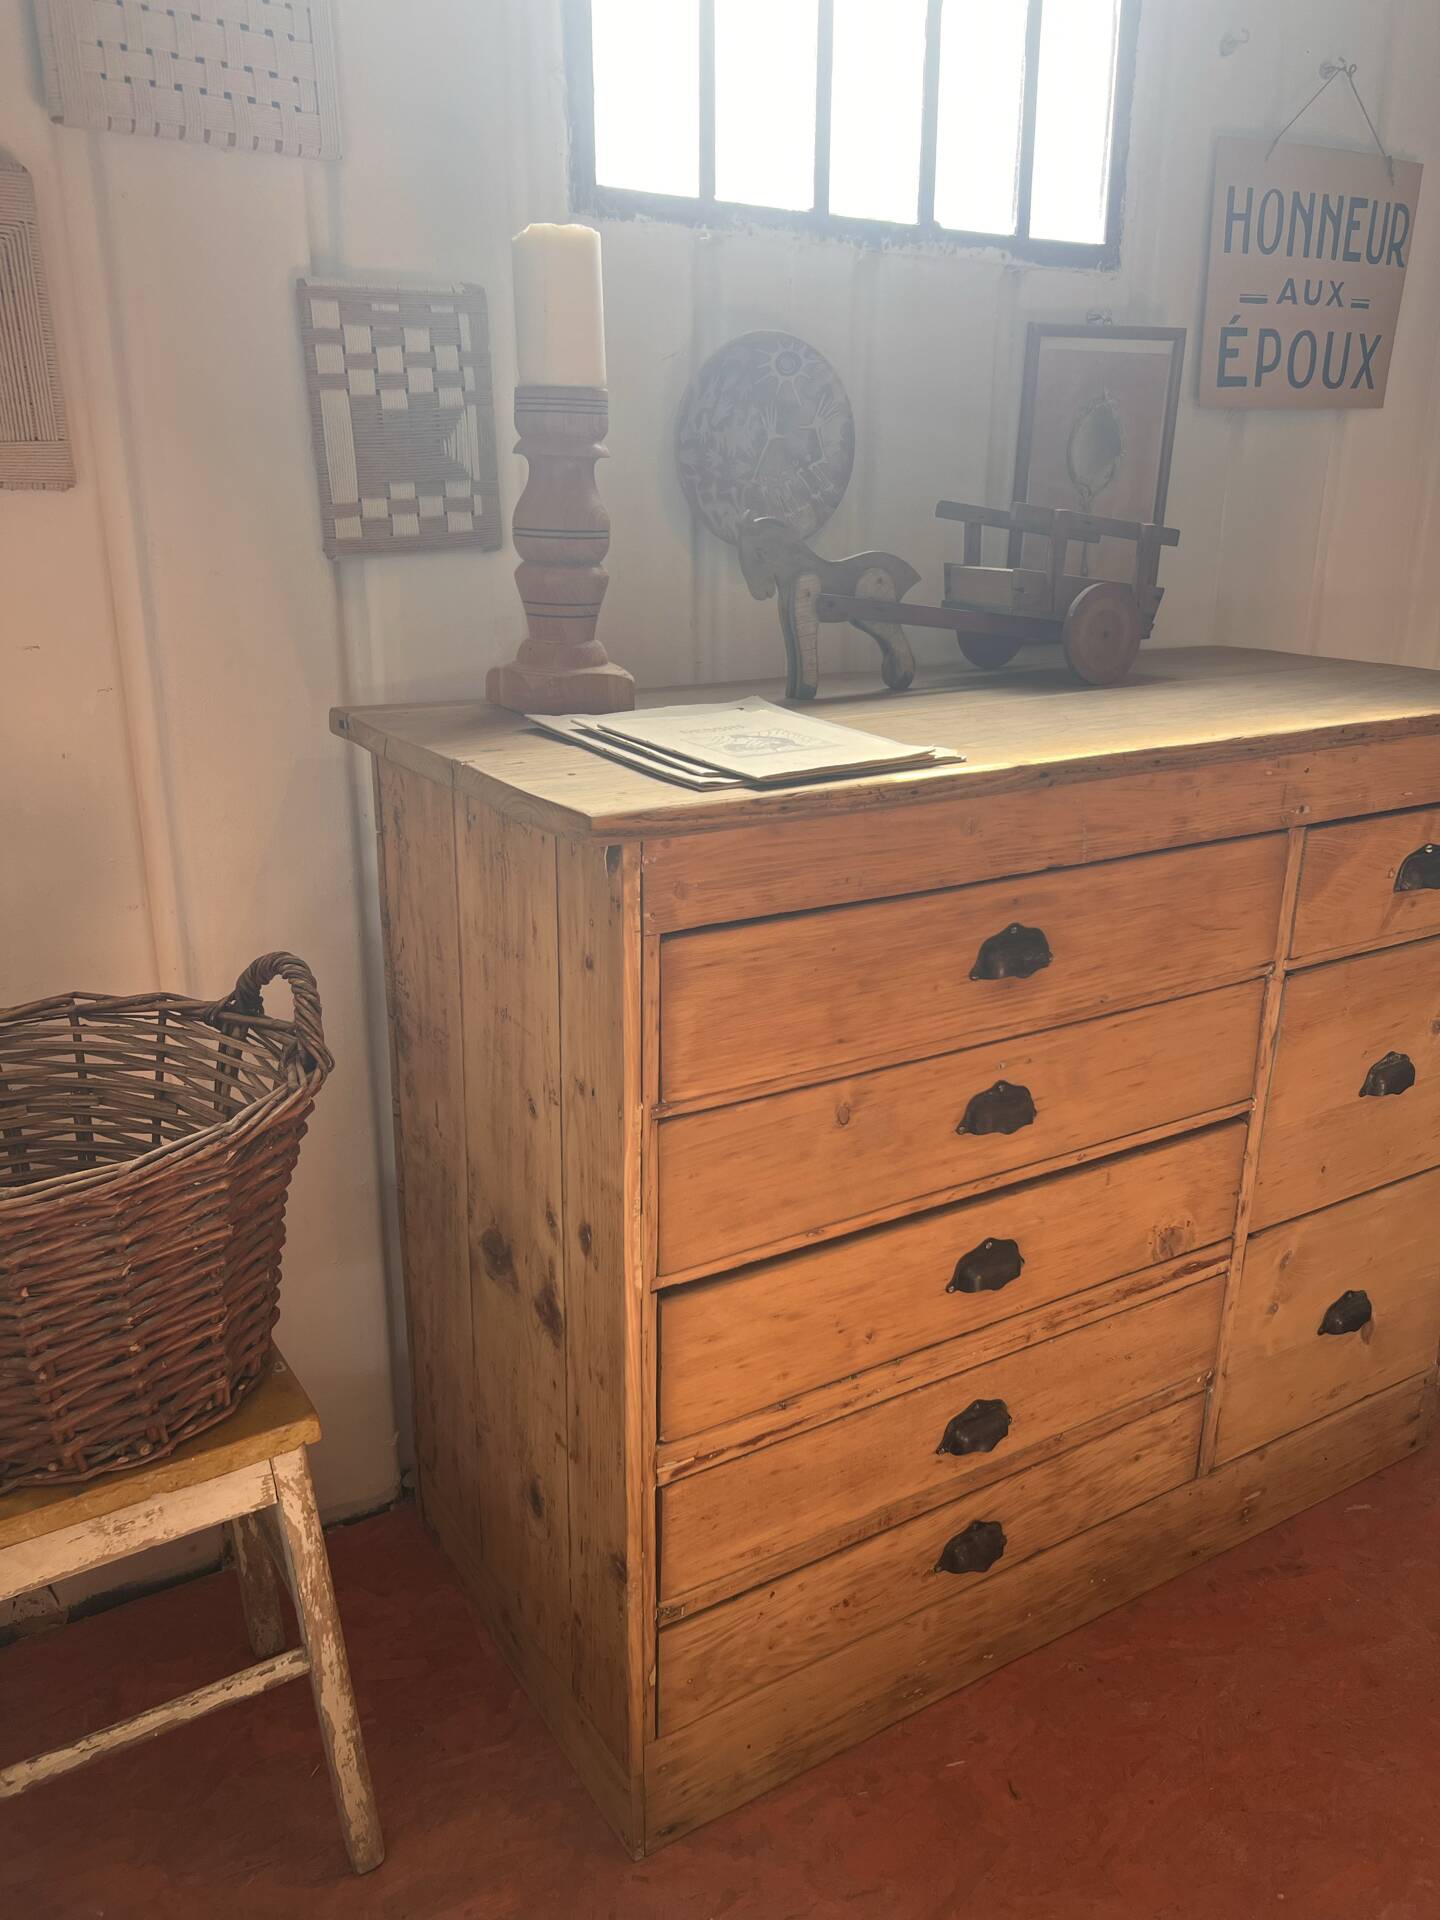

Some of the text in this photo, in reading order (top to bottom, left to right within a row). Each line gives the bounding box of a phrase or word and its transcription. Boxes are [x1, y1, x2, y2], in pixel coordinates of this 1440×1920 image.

[1224, 185, 1410, 268] HONNEUR
[1276, 278, 1344, 307] AUX
[1216, 314, 1382, 389] ÉPOUX
